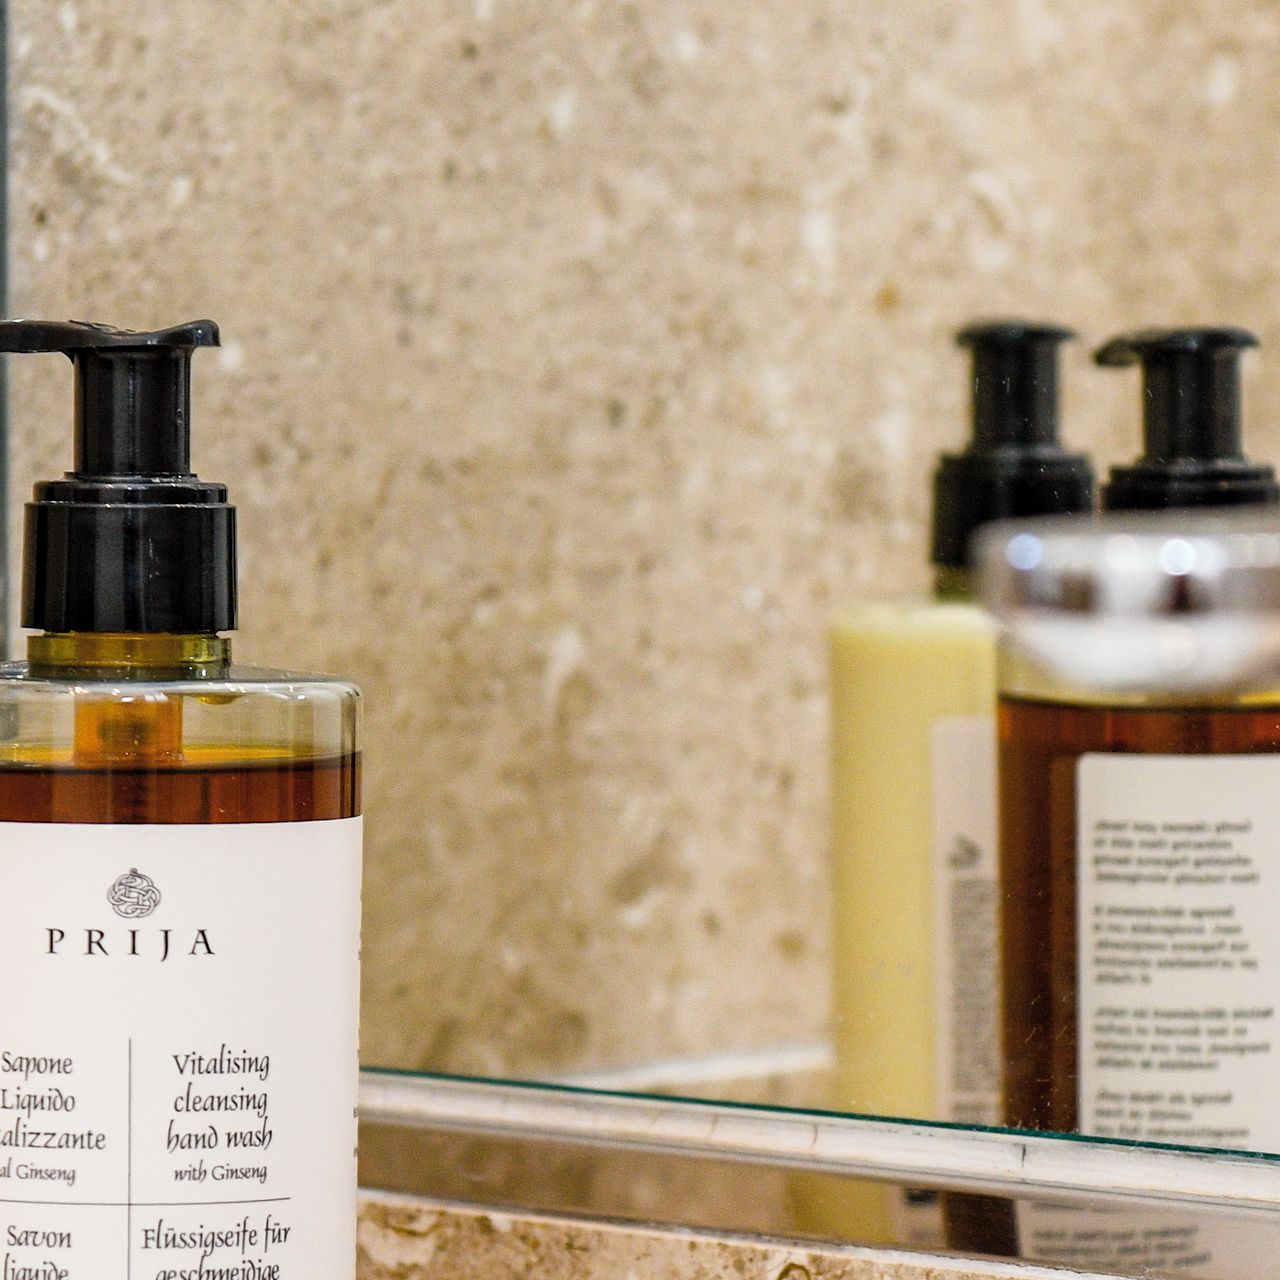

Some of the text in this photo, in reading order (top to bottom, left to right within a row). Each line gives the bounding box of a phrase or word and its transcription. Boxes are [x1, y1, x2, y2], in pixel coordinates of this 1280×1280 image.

[46, 928, 215, 962] PRIJA
[1, 1051, 73, 1081] Sapone
[172, 1043, 270, 1081] Vitalising
[0, 1086, 75, 1119] Liquido
[174, 1082, 268, 1119] cleansing
[167, 1115, 272, 1154] hand wash
[0, 1157, 76, 1187] al Ginseng
[174, 1159, 267, 1184] with Ginseng
[7, 1225, 71, 1248] Savon
[141, 1214, 291, 1258] Flüssigseife für
